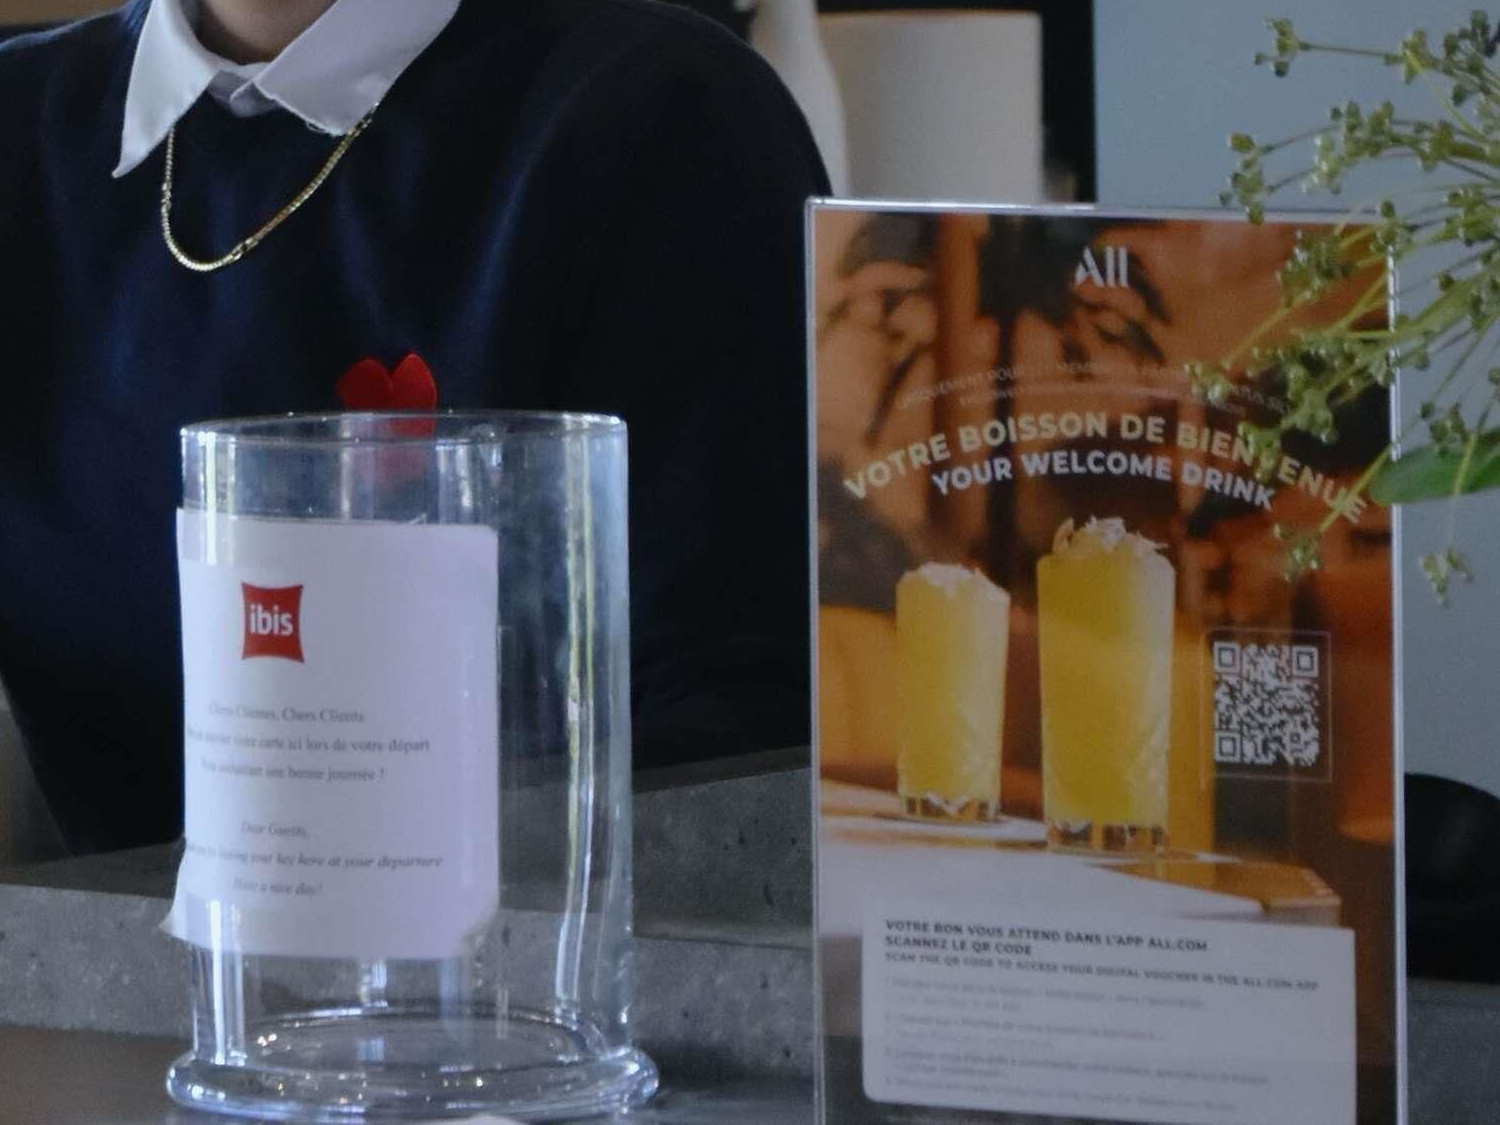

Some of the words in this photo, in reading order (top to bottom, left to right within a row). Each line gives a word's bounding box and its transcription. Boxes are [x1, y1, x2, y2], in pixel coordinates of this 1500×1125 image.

[843, 432, 951, 499] VOTRE
[957, 411, 1108, 453] BOISSON
[1119, 412, 1165, 444] DE
[1176, 419, 1368, 526] BIENENUE
[932, 457, 1013, 495] YOUR
[1021, 449, 1172, 482] WELCOME
[1181, 461, 1276, 513] DRINK
[249, 603, 293, 636] ibis
[305, 736, 329, 751] lors
[333, 738, 347, 751] de
[351, 739, 383, 752] votre
[389, 738, 430, 754] départ
[885, 919, 929, 932] VOTRE
[934, 922, 963, 935] BON
[967, 923, 1004, 937] VOUS
[1008, 926, 1060, 941] ATTEND
[1065, 930, 1102, 944] DANS
[885, 935, 946, 949] SCANNEZ
[951, 939, 967, 951] LE
[972, 941, 991, 954] QR
[995, 942, 1032, 955] CODE
